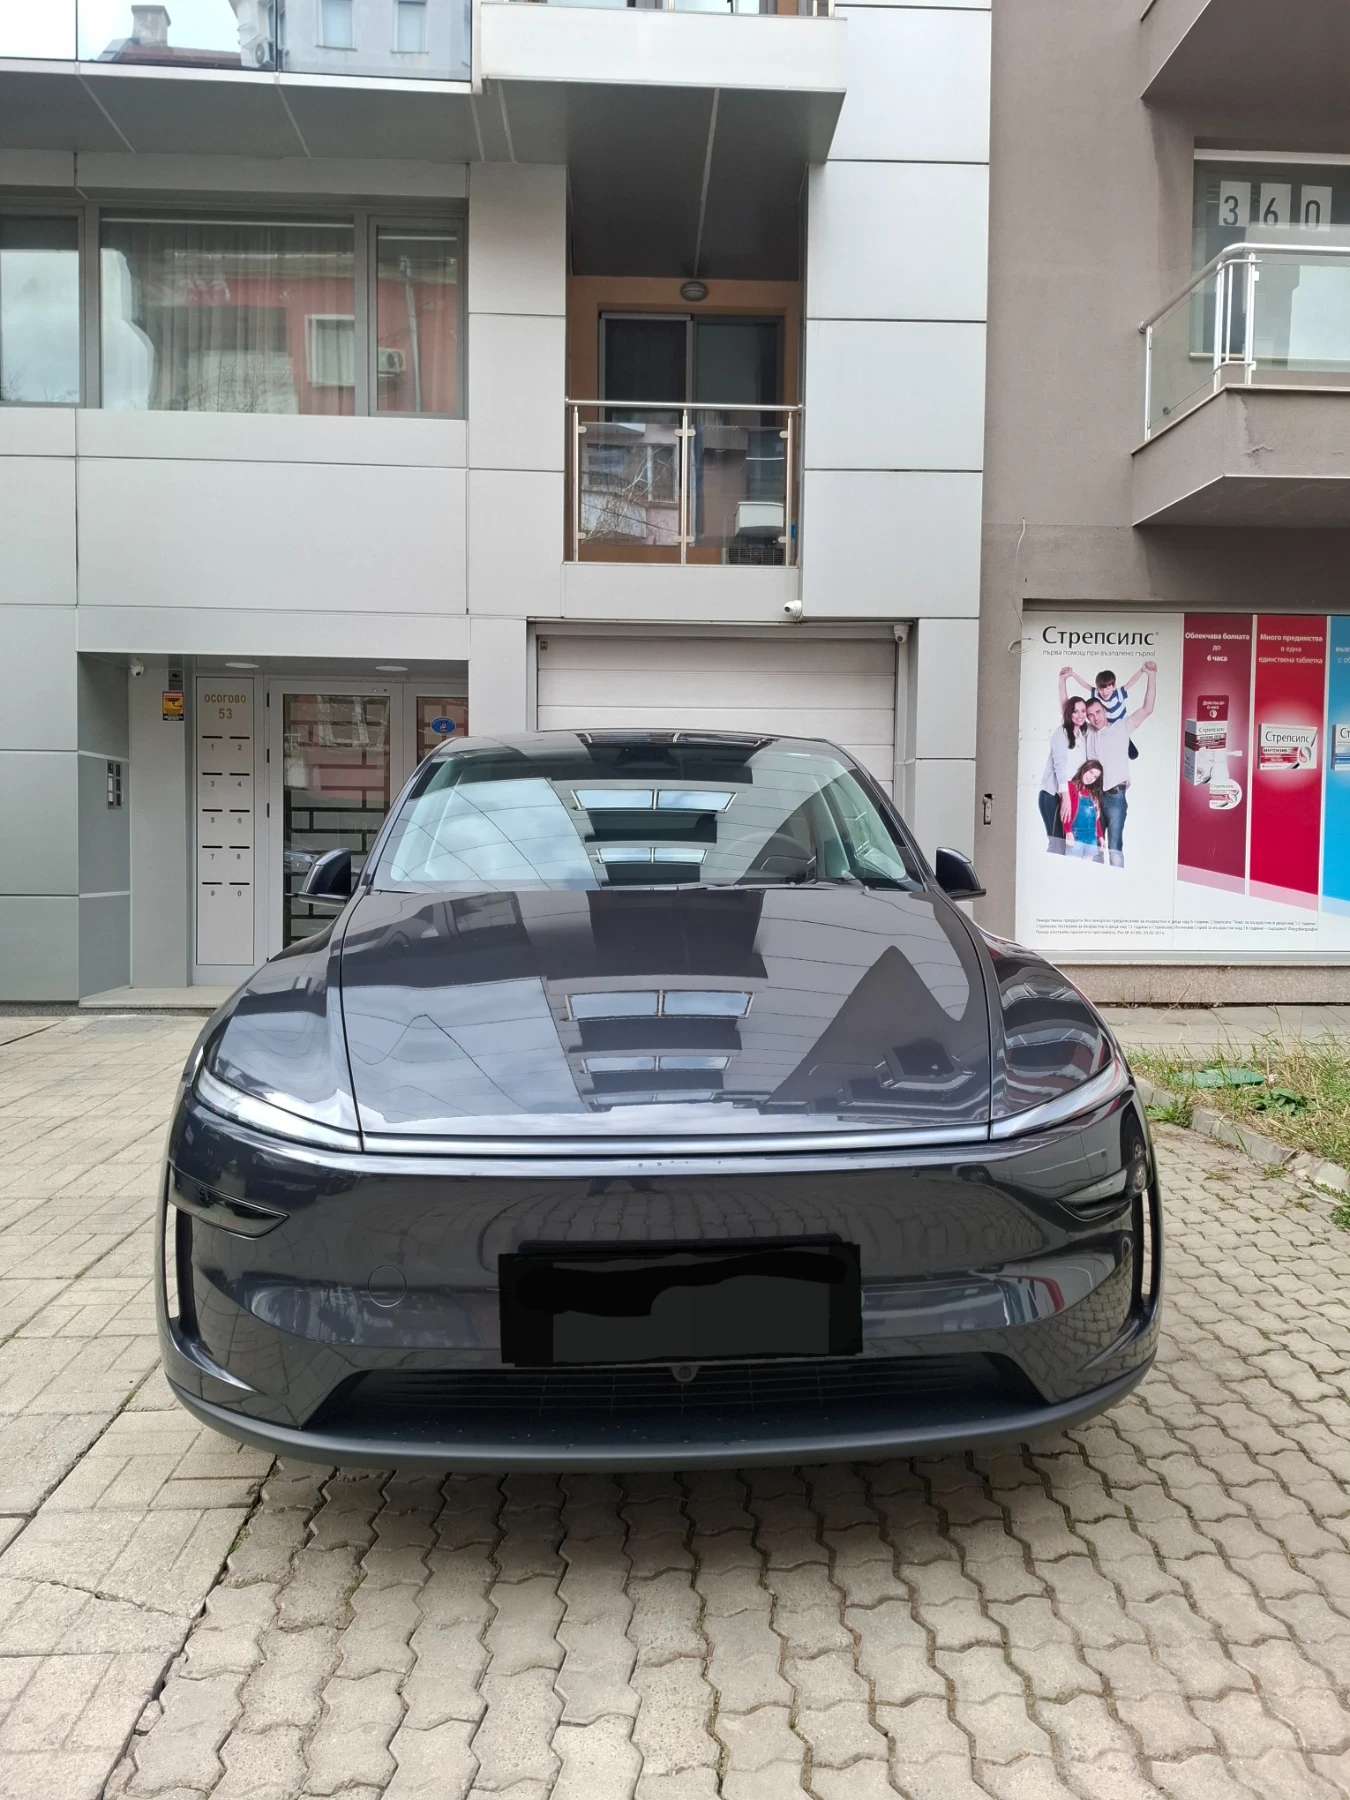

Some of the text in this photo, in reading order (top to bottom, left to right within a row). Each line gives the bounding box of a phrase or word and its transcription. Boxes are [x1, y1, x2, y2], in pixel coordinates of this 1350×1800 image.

[1042, 625, 1155, 649] Стрепсилс
[1260, 633, 1282, 641] Много
[1206, 654, 1212, 662] 6
[204, 693, 247, 704] ОСОГОВО
[218, 707, 233, 720] 53
[1265, 731, 1310, 745] Стрепсилс
[210, 743, 215, 751] 1
[237, 743, 243, 751] 2
[210, 780, 215, 788] 3
[237, 780, 242, 788] 4
[211, 816, 216, 824] 5
[237, 817, 242, 825] 6
[210, 853, 215, 861] 7
[236, 853, 241, 861] 8
[210, 889, 215, 897] 9
